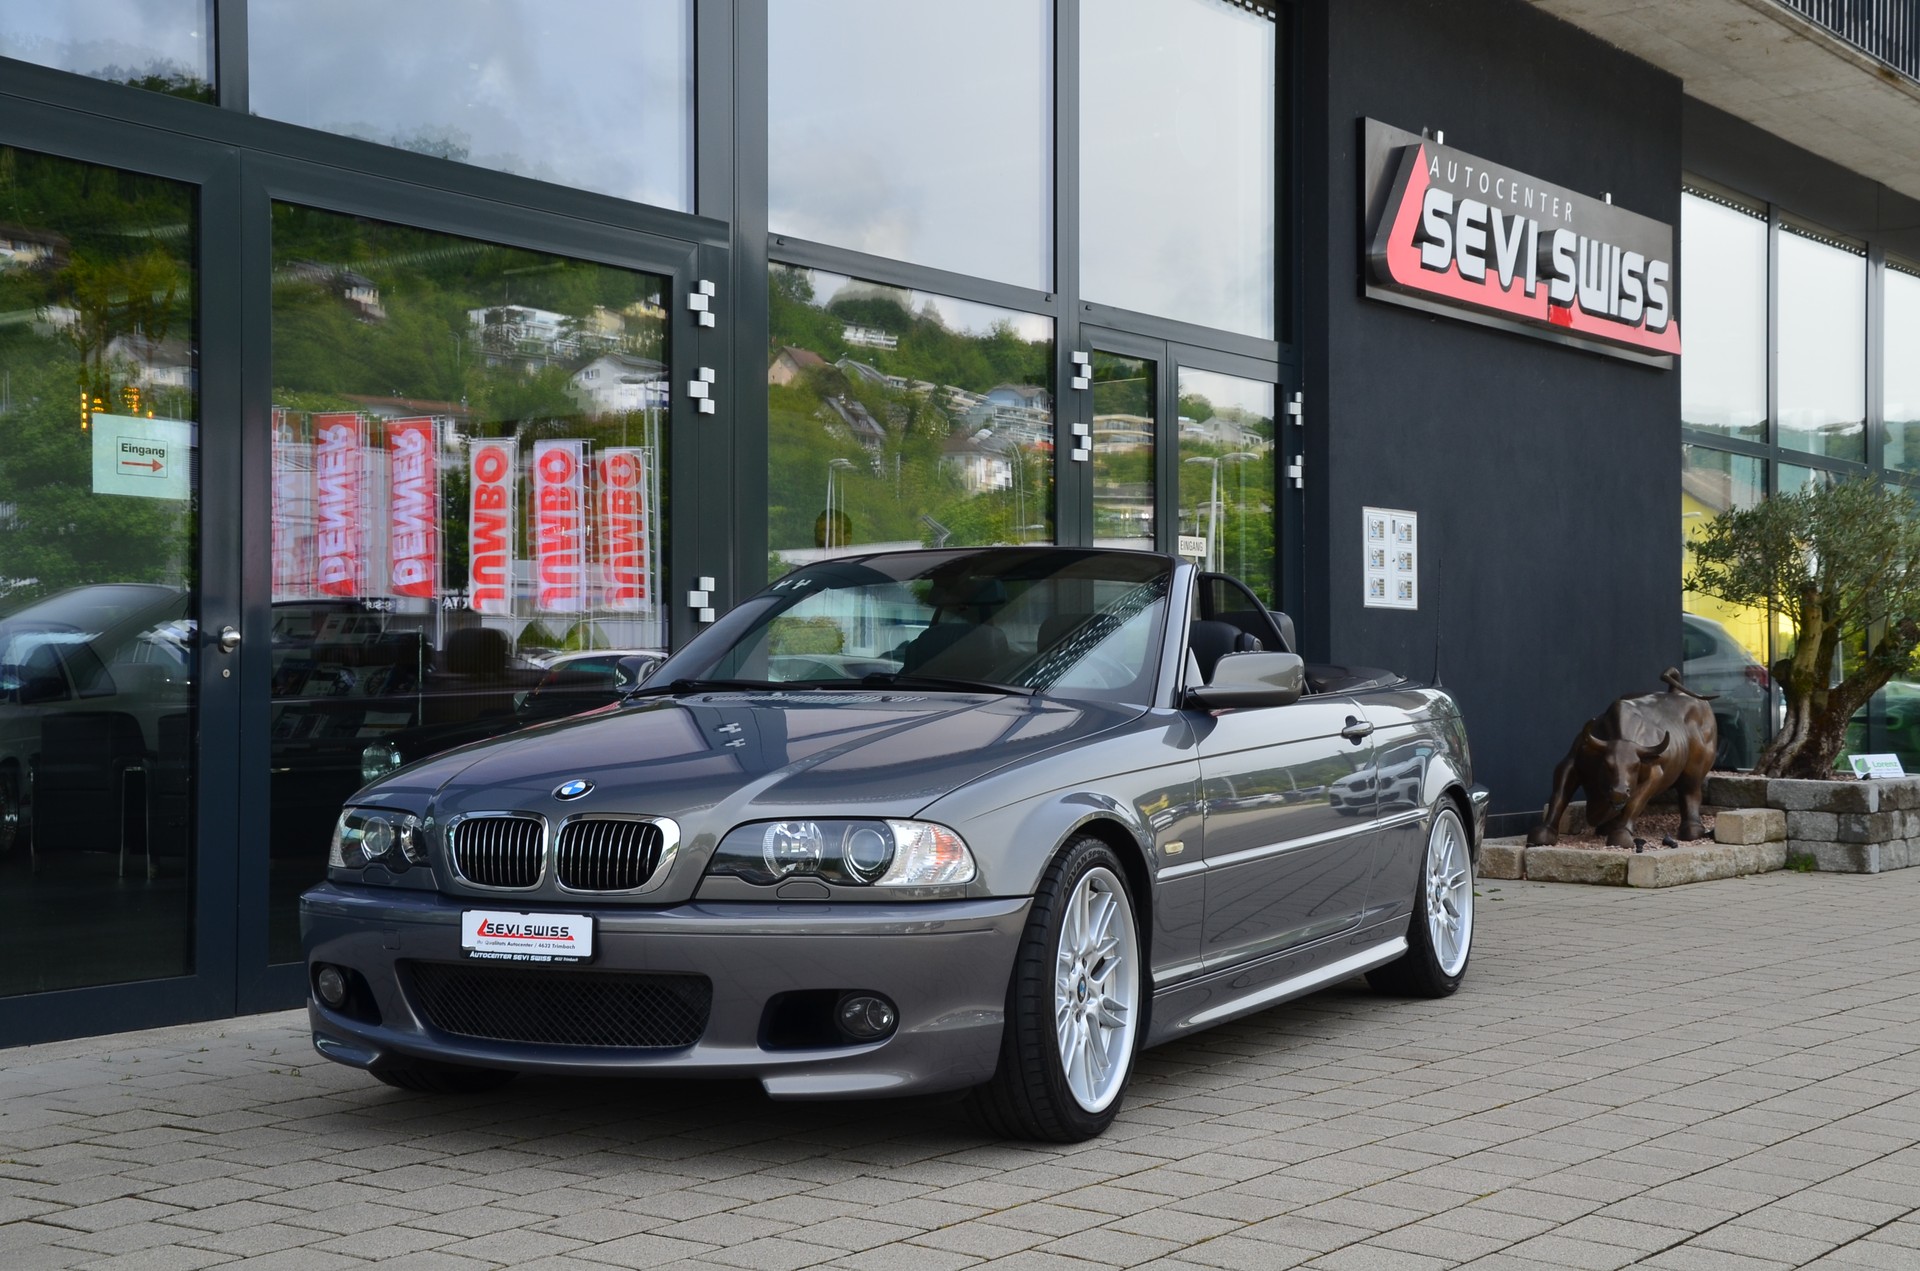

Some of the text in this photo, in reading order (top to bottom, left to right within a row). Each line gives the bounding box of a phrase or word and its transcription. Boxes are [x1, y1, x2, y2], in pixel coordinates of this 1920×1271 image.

[1429, 155, 1573, 223] AUTOCENTER
[1420, 187, 1669, 329] SEVI SWISS
[121, 443, 166, 458] Eingang
[1180, 540, 1204, 552] EINGANG
[486, 923, 569, 937] SEVI SWISS
